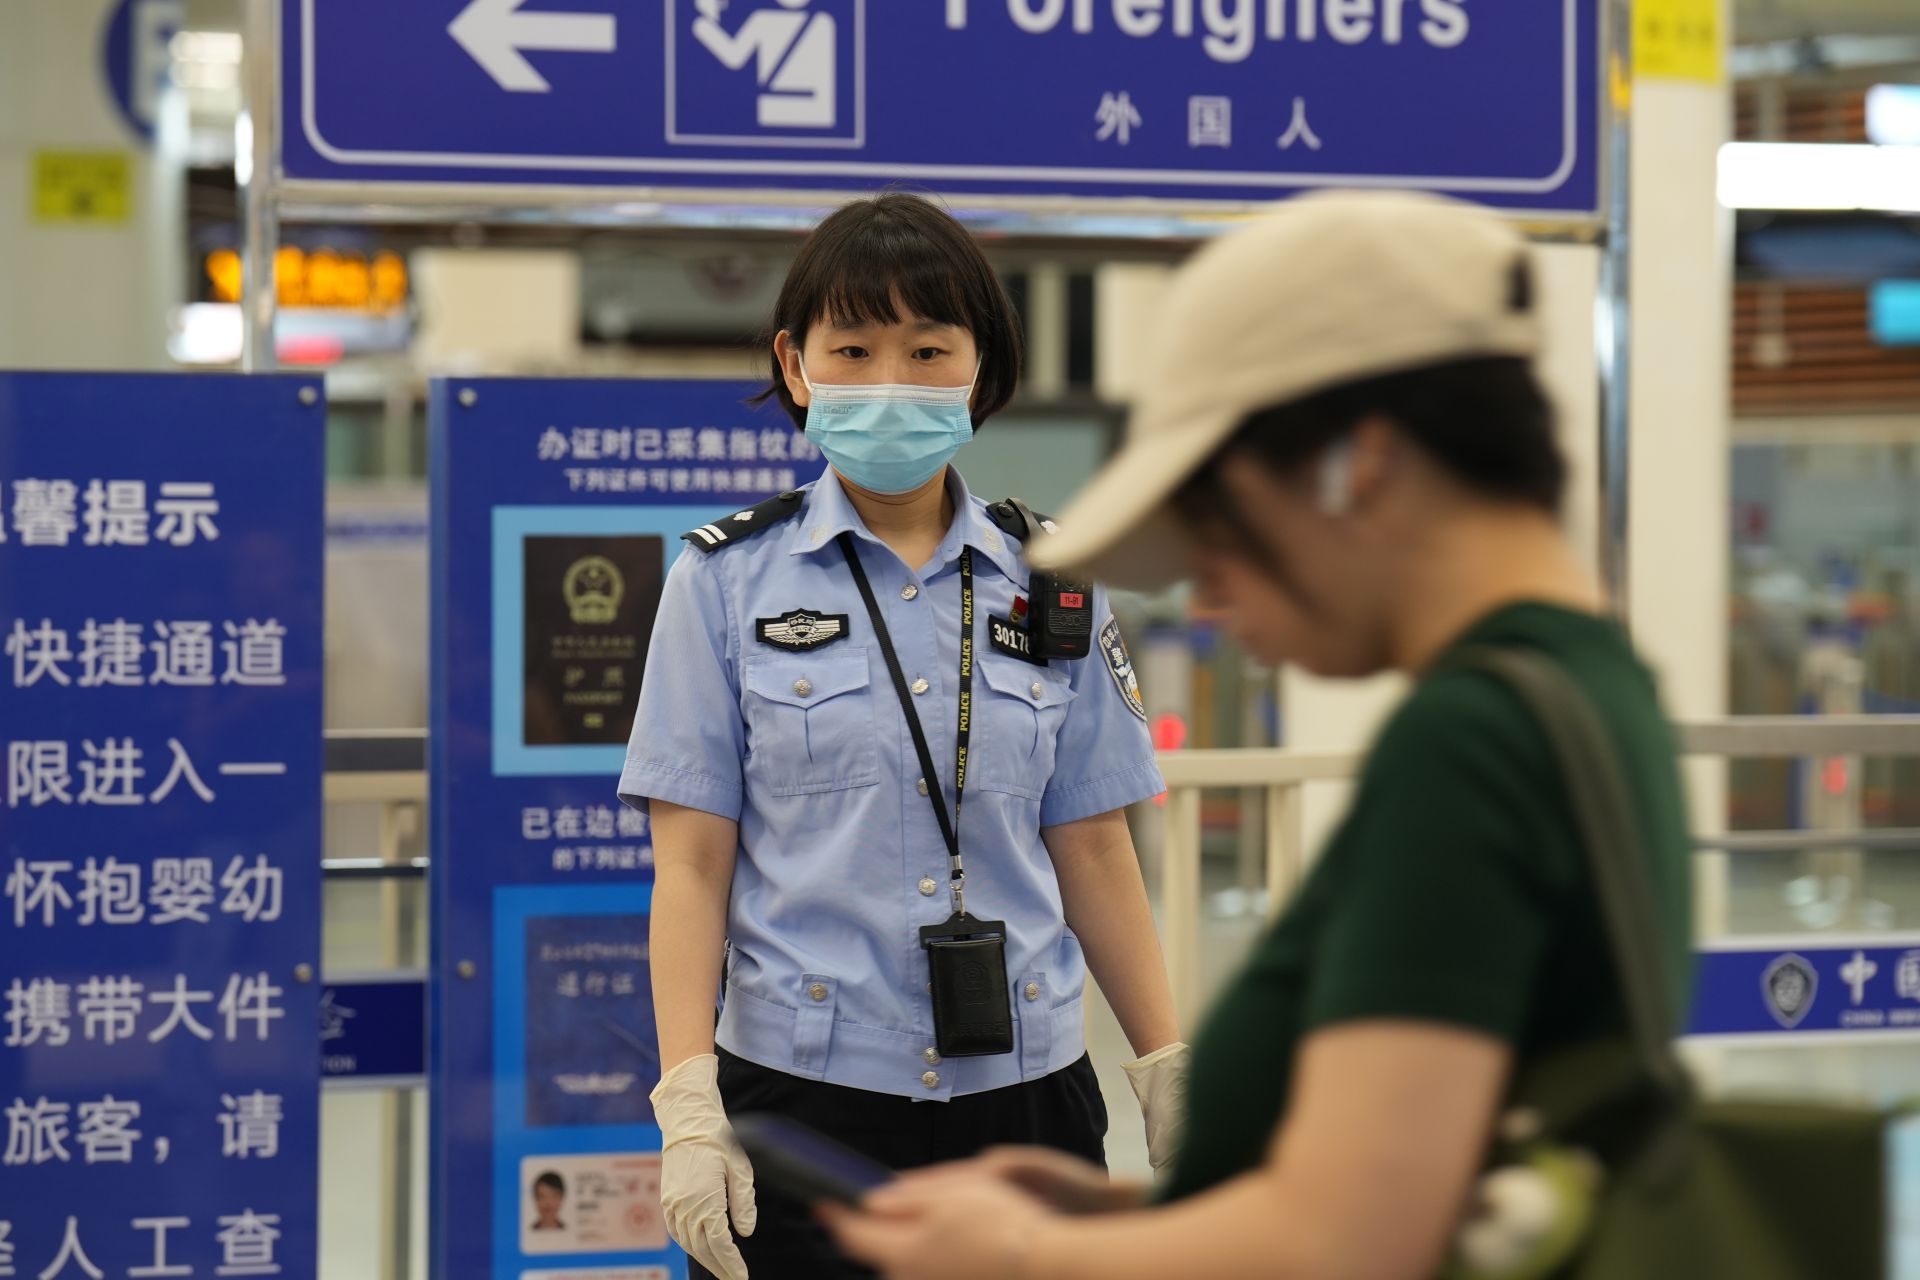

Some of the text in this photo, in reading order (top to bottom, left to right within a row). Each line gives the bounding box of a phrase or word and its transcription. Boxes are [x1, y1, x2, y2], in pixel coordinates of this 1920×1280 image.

[1095, 91, 1322, 151] 外国人
[0, 478, 220, 546] 馨提示
[963, 588, 972, 625] POLICE
[6, 617, 287, 687] 快捷通道
[962, 638, 971, 677] POLICE
[993, 623, 1030, 655] 3017
[960, 692, 969, 732] POLICE
[957, 747, 966, 788] POLICE
[5, 853, 283, 928] 怀抱婴幼
[4, 971, 285, 1046] 携带大件
[0, 1207, 282, 1280] 人工查
